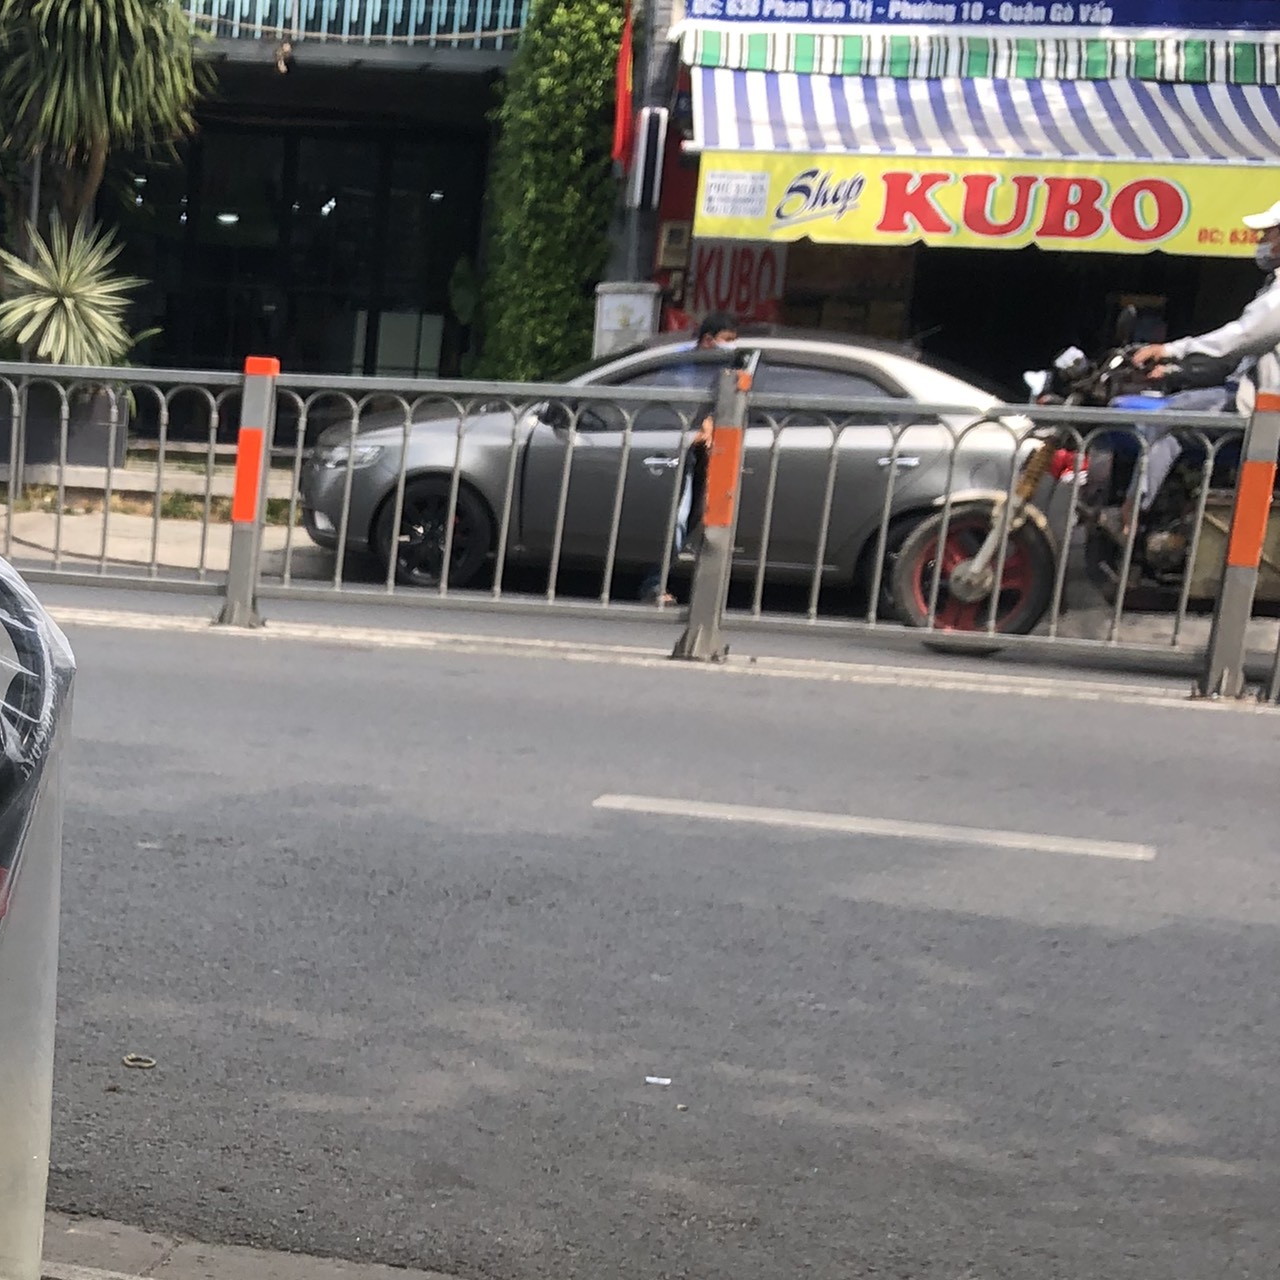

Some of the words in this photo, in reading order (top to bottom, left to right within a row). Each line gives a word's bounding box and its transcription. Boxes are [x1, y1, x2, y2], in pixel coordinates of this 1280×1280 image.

[960, 1, 984, 21] 10
[775, 168, 867, 221] Shop
[875, 171, 1190, 243] KUBO
[694, 244, 777, 313] KUBO
